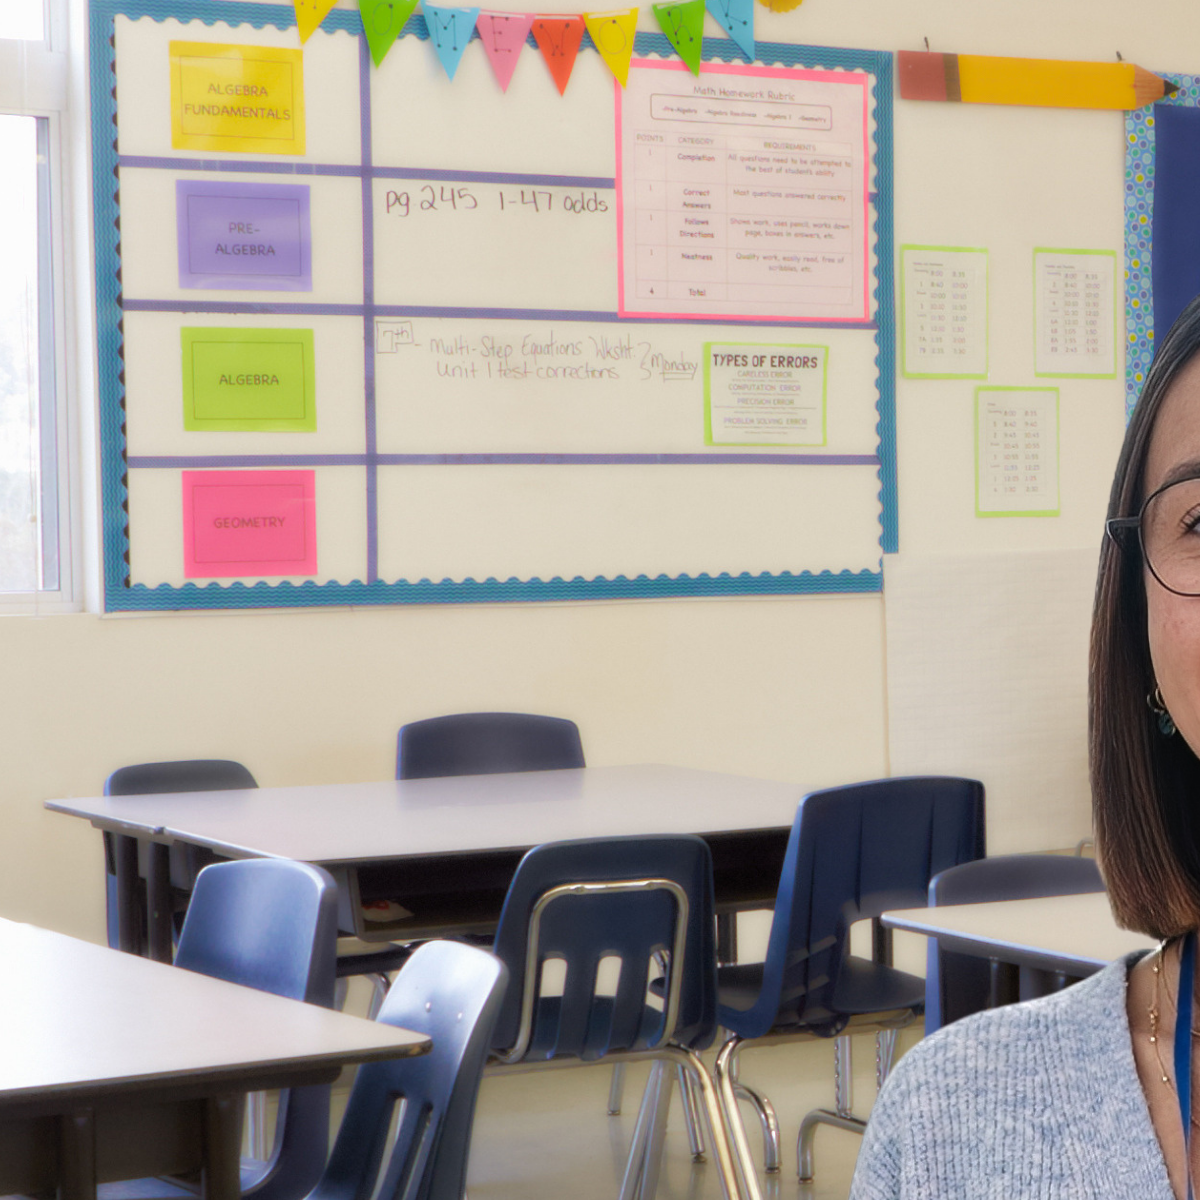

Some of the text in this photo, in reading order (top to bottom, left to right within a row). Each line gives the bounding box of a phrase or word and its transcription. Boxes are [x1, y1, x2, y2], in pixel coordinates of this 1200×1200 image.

[207, 83, 268, 97] ALGEBRA
[693, 85, 796, 102] Math Homework Rubric
[184, 103, 291, 121] FUNDAMENTALS
[420, 185, 478, 210] 245
[499, 190, 553, 212] 1-47
[563, 192, 608, 214] odds
[228, 222, 261, 235] PRE-
[215, 244, 275, 257] ALGEBRA
[713, 353, 818, 369] TYPES OF ERRORS
[436, 362, 476, 379] Unit
[219, 374, 280, 386] ALGEBRA
[213, 516, 286, 530] GEOMETRY
